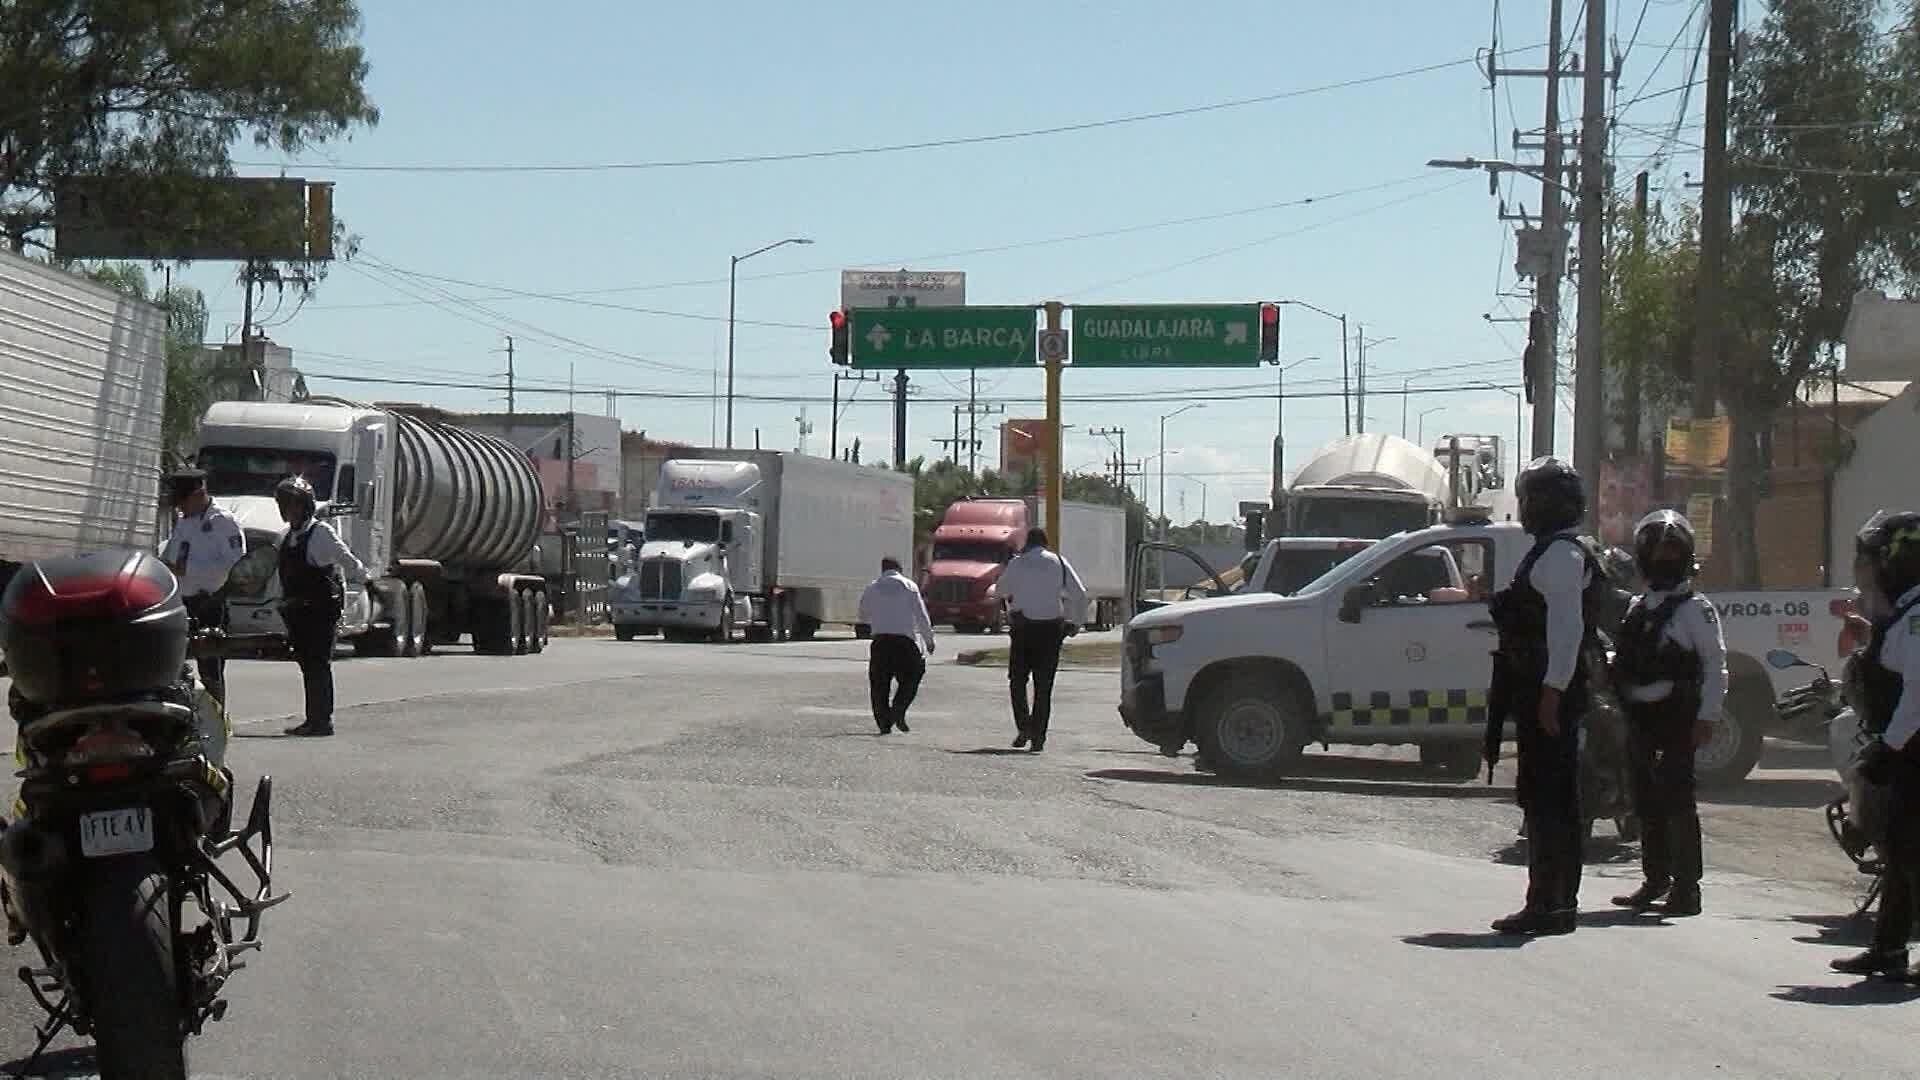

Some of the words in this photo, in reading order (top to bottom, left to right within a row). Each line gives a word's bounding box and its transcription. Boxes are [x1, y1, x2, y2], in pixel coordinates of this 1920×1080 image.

[904, 327, 936, 350] LA
[943, 327, 1025, 350] BARCA
[1083, 317, 1216, 339] GUADALAJARA
